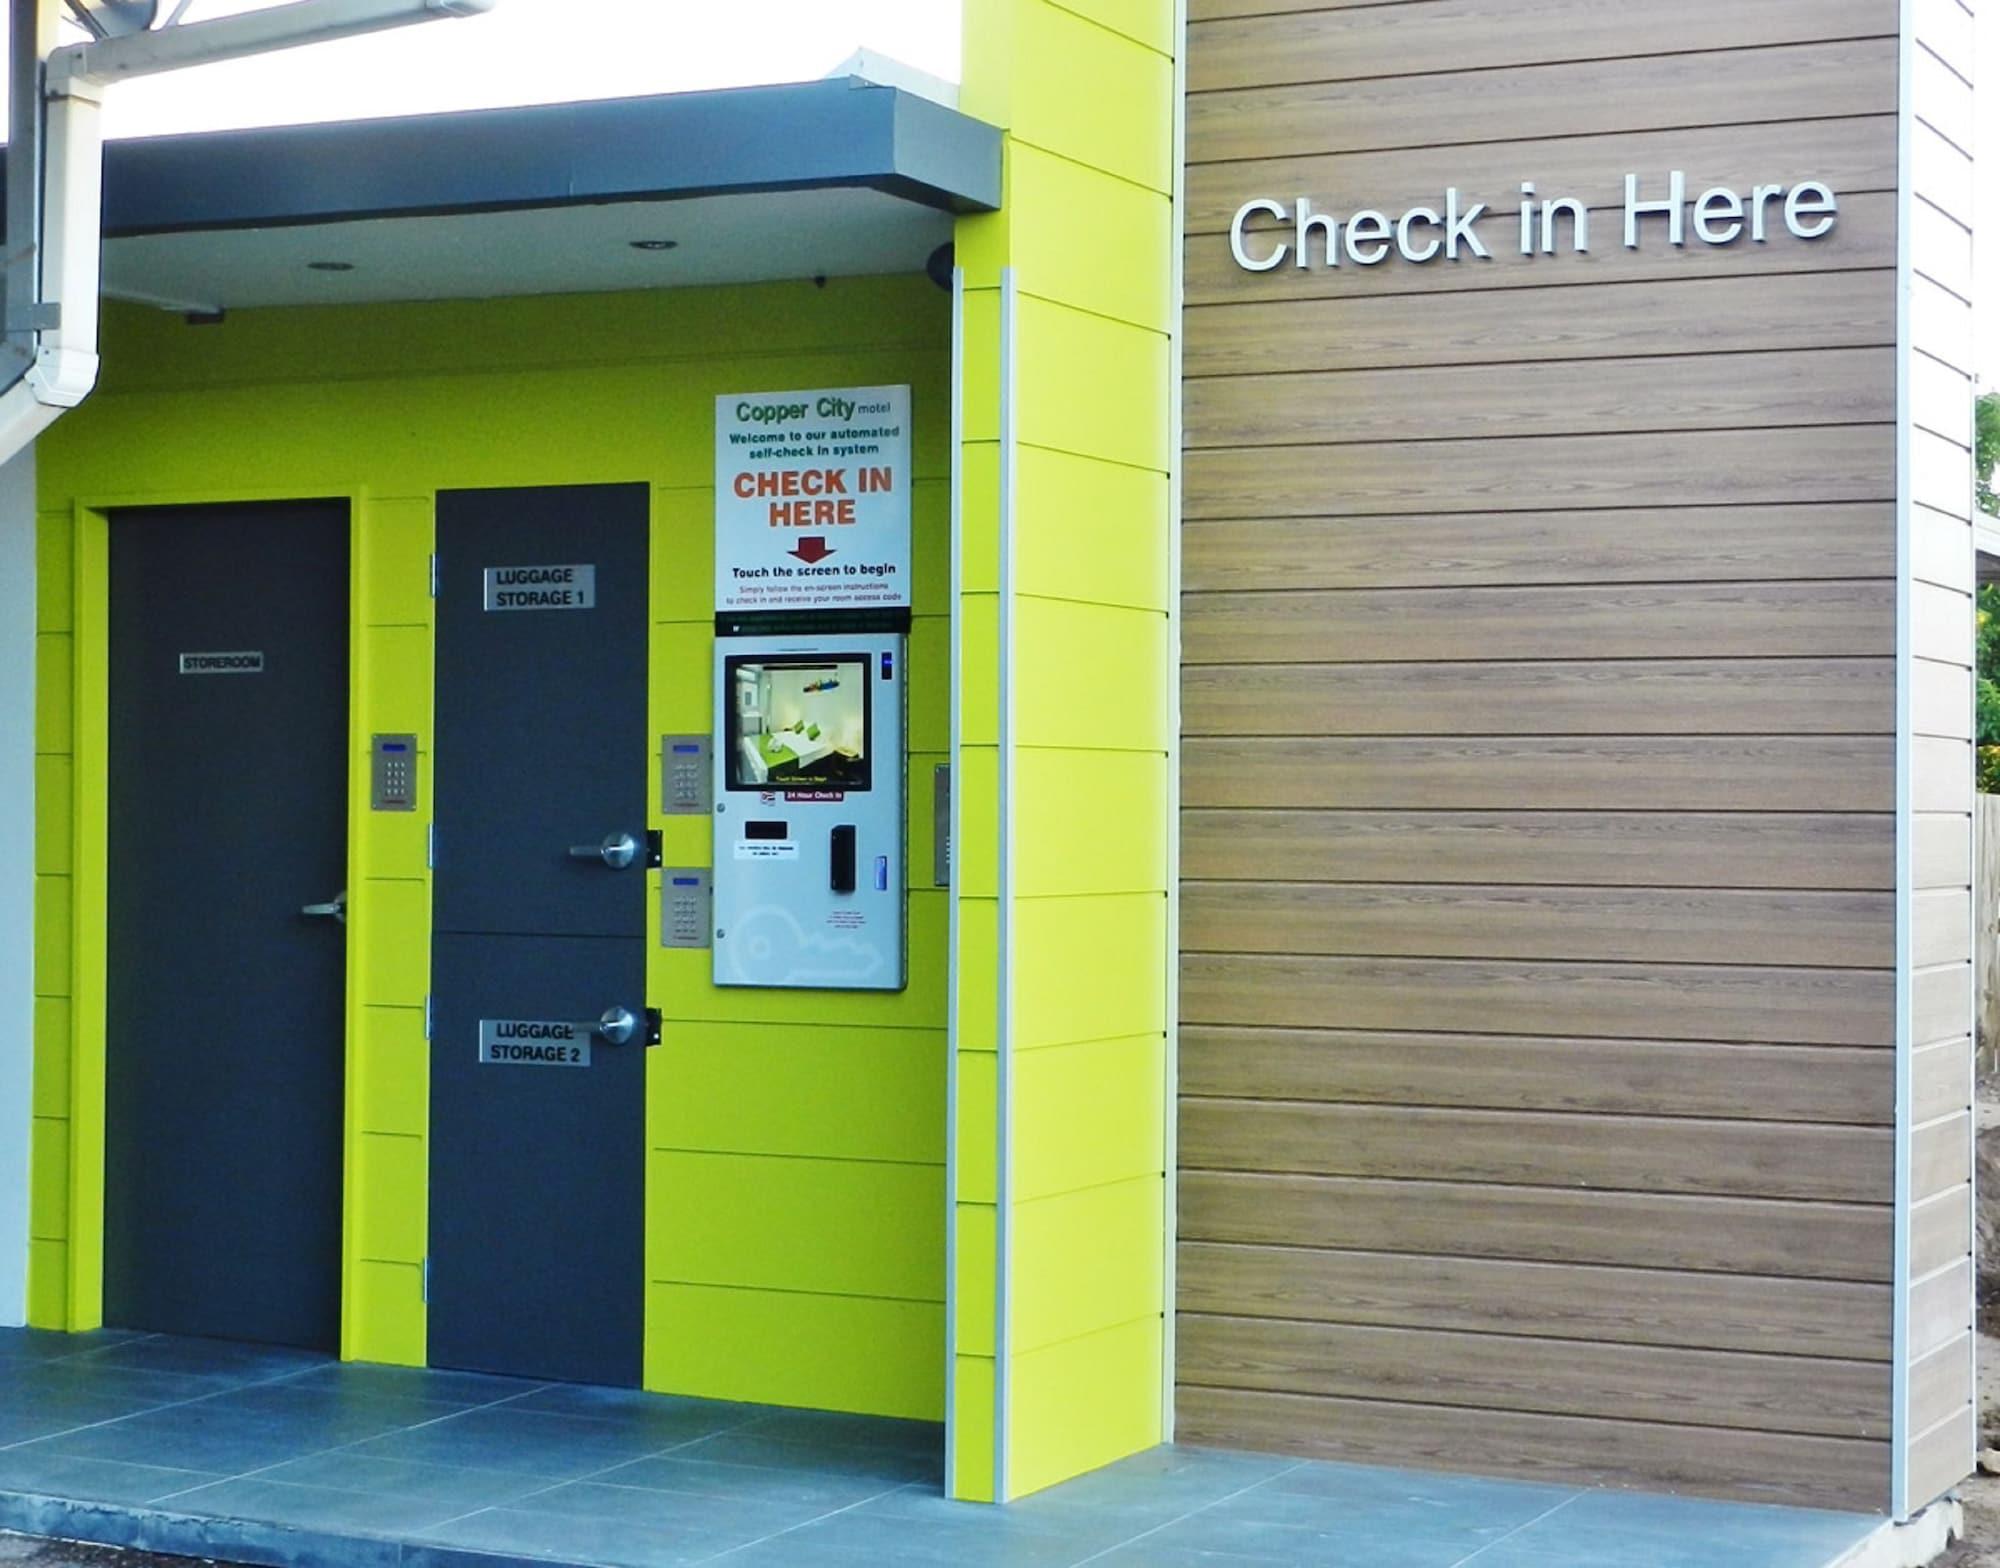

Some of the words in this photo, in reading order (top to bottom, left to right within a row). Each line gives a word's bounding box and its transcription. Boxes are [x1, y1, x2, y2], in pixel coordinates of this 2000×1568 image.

[1229, 187, 1490, 271] Check
[1520, 182, 1588, 256] in
[1624, 170, 1838, 248] Here
[736, 402, 809, 425] Copper
[816, 397, 856, 421] City
[858, 402, 891, 414] motel
[729, 432, 785, 444] Welcome
[789, 431, 801, 441] to
[806, 431, 826, 440] our
[830, 427, 900, 440] automated
[749, 445, 814, 459] self-check
[817, 445, 829, 456] in
[833, 443, 879, 457] system
[733, 468, 847, 498] CHECK
[858, 466, 892, 493] IN
[769, 500, 856, 527] HERE
[496, 568, 573, 585] LUGGAGE
[732, 567, 769, 578] Touch
[773, 566, 793, 577] the
[797, 565, 840, 577] screen
[844, 564, 856, 575] to
[860, 562, 896, 577] begin
[739, 585, 764, 594] Simply
[843, 582, 889, 591] instructions
[882, 592, 902, 600] code
[496, 590, 572, 606] STORAGE
[577, 590, 584, 604] 1
[184, 656, 260, 669] STOREROOM
[496, 1023, 574, 1040] LUGGAGE
[491, 1044, 567, 1061] STORAGE
[570, 1048, 581, 1062] 2
